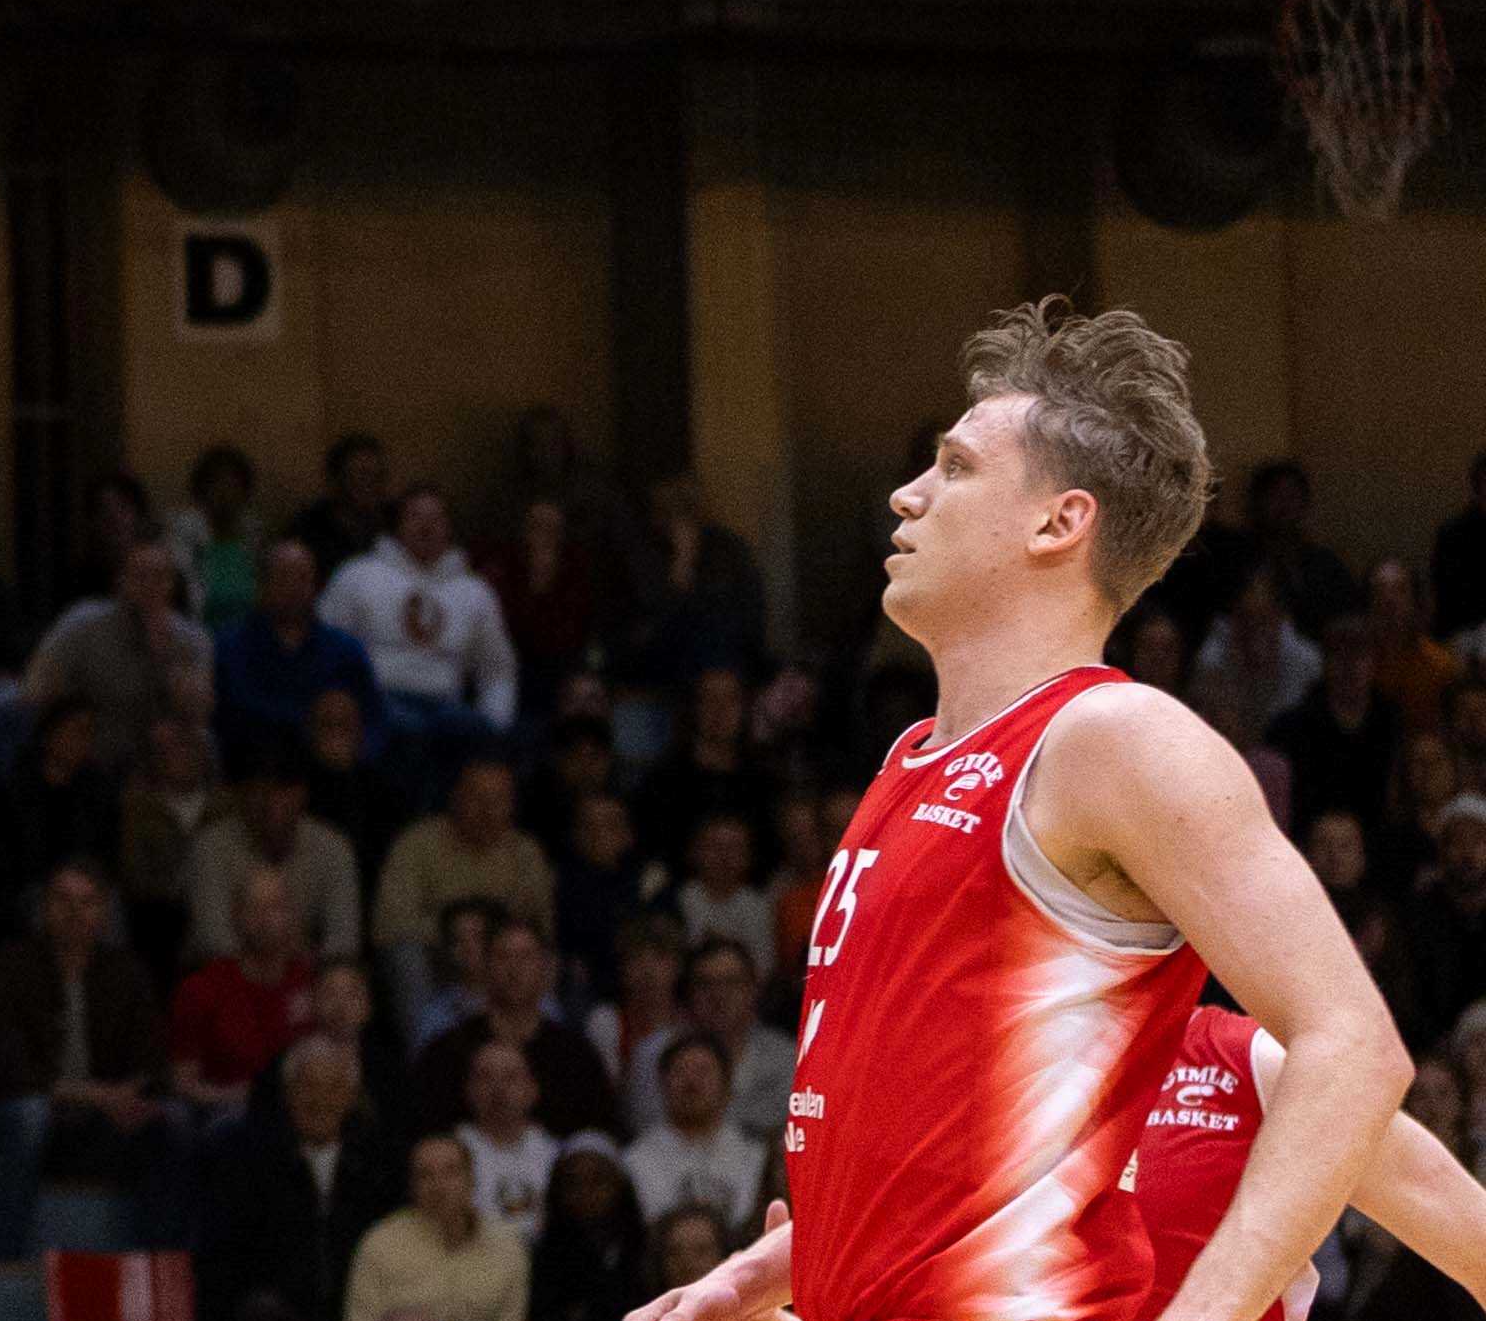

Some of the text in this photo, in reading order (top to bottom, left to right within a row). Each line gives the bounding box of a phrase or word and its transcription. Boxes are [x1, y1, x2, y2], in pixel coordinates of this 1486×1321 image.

[185, 232, 271, 326] D
[807, 847, 881, 967] 25
[1144, 1107, 1240, 1132] BASKET
